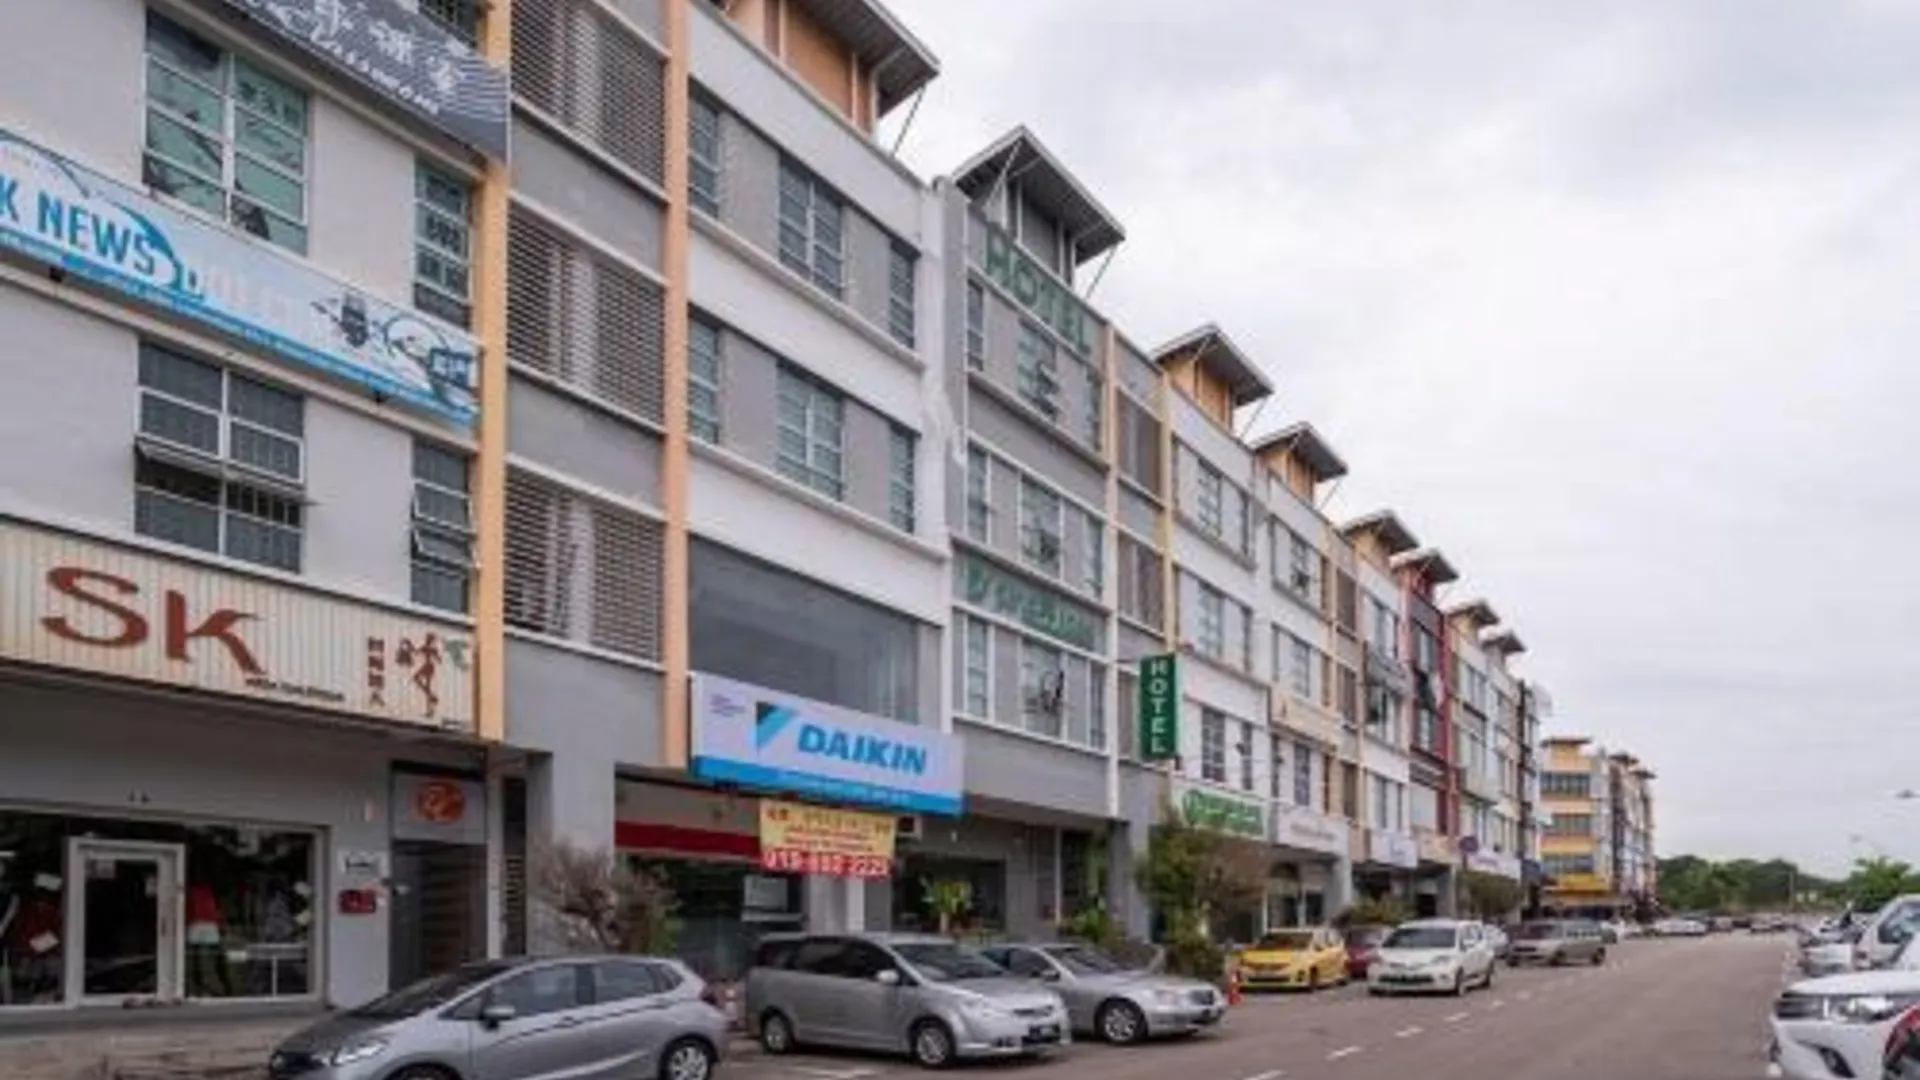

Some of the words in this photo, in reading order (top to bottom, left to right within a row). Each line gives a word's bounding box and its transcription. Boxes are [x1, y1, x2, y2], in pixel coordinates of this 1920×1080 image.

[37, 190, 155, 276] NEWS
[985, 228, 1091, 357] HOTEL
[41, 565, 268, 676] SK
[798, 723, 927, 775] DAIKIN
[1148, 660, 1168, 754] HOTEL
